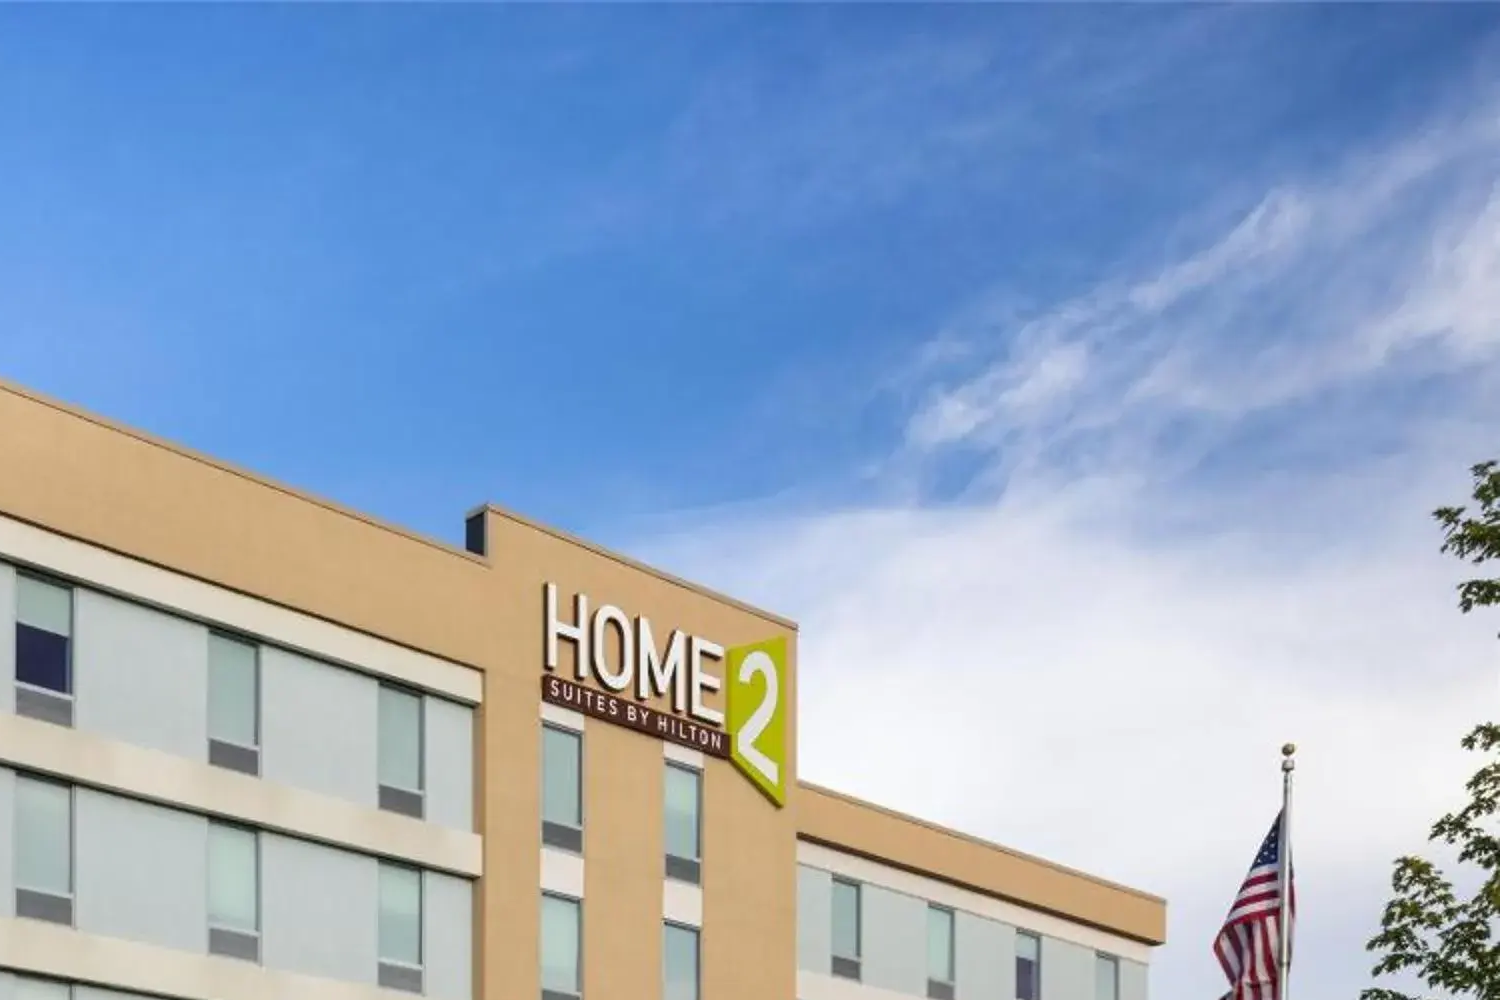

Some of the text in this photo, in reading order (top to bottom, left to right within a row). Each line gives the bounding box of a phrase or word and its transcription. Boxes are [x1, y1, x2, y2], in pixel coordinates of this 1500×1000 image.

[544, 581, 779, 787] HOME 2
[550, 679, 722, 750] SUITES BY HILTON
